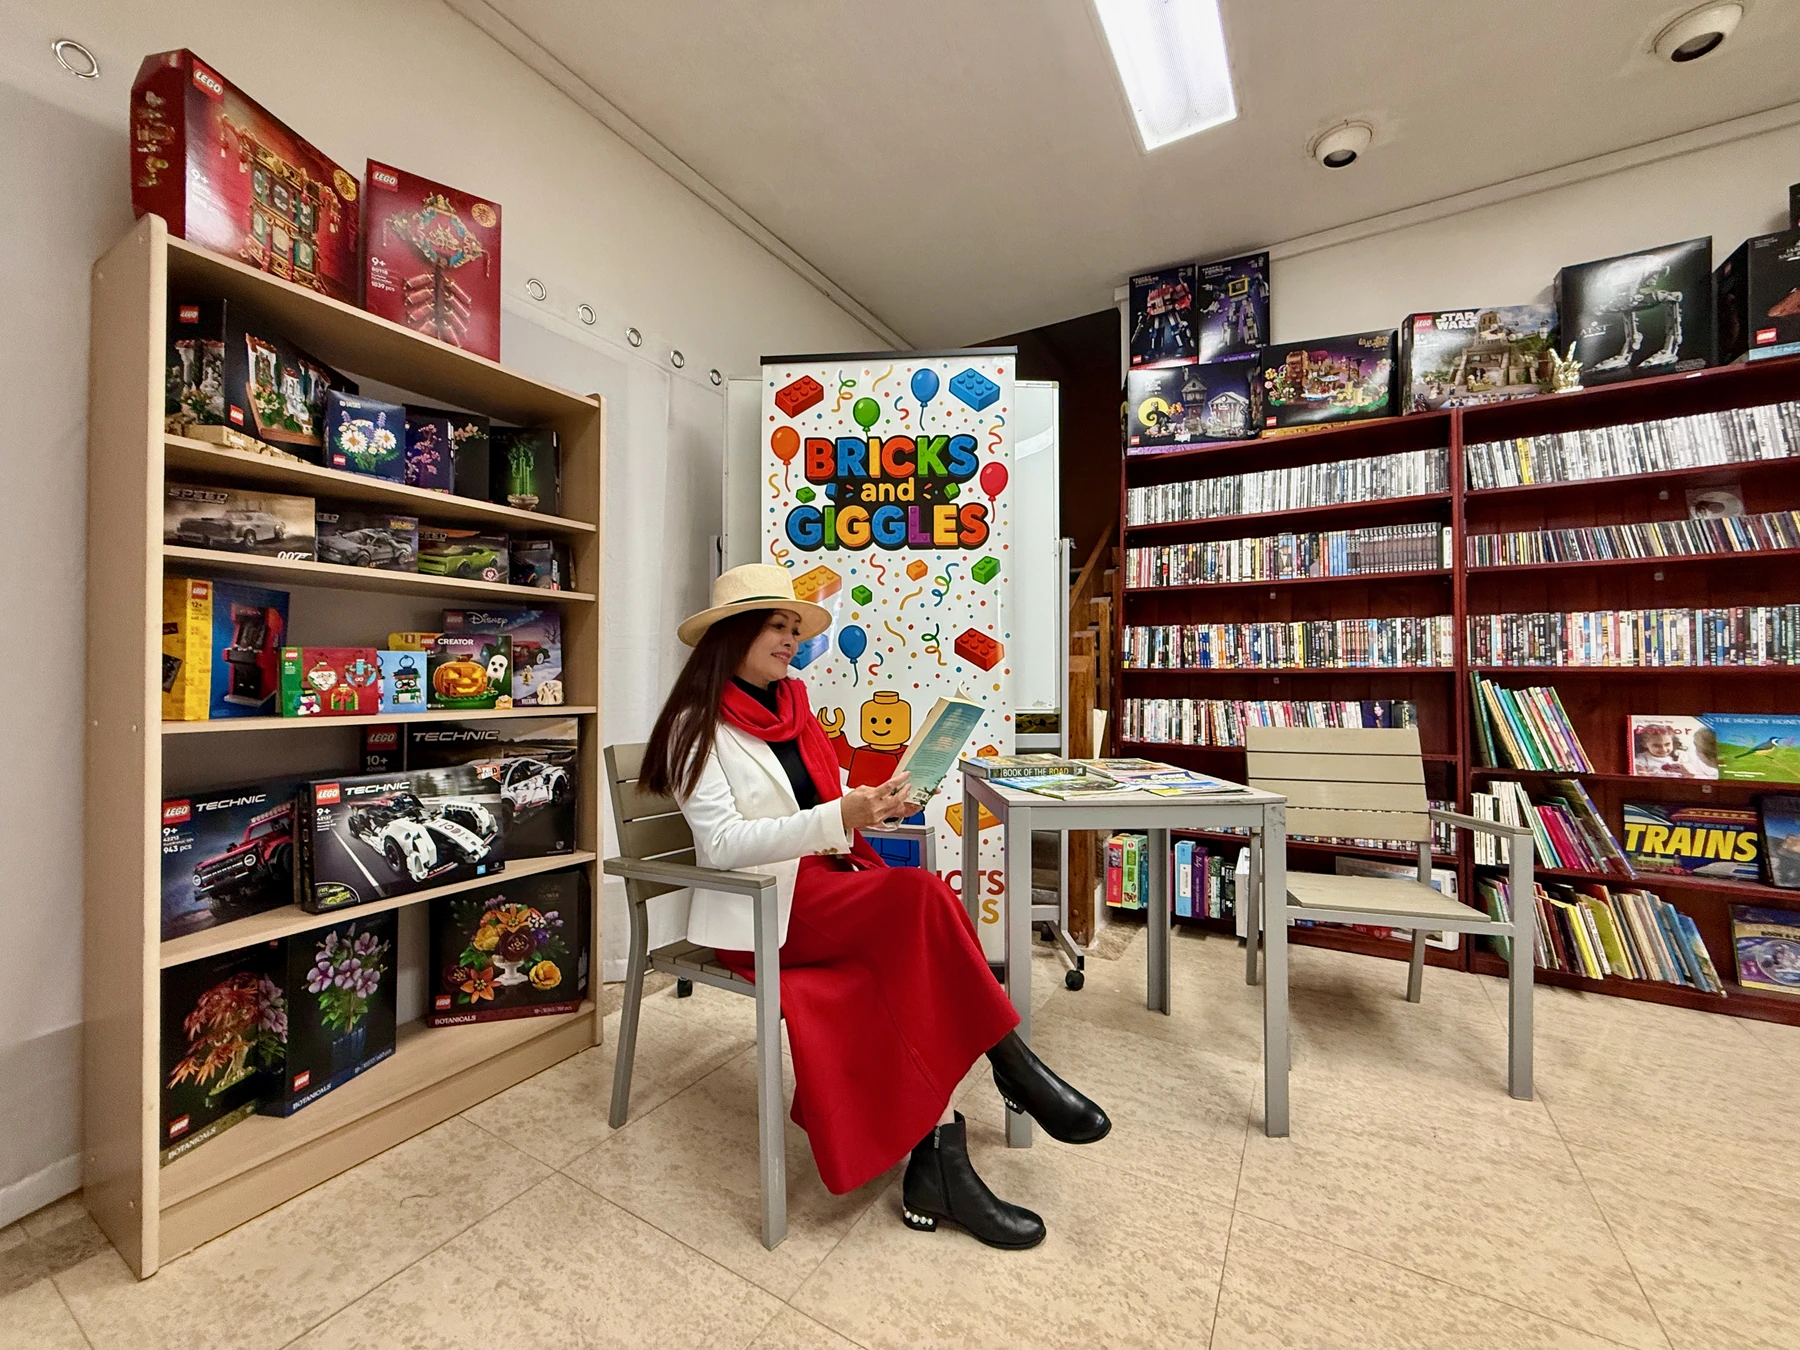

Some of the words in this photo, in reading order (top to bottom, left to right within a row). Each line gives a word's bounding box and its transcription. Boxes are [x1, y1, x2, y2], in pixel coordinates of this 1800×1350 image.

[195, 70, 222, 94] LEGO
[373, 171, 397, 186] LEGO
[371, 256, 386, 266] 9+
[180, 309, 198, 319] LEGO
[1441, 311, 1477, 322] STAR
[1436, 319, 1477, 330] WARS
[804, 434, 979, 482] BRICKS
[168, 488, 229, 502] SPEED
[860, 476, 915, 502] and
[786, 502, 990, 550] GIGGLES
[447, 616, 463, 625] LEGO
[466, 611, 508, 627] Disney
[421, 637, 435, 646] LEGO
[437, 638, 474, 647] CREATOR
[369, 731, 397, 743] LEGO
[412, 730, 500, 742] TECHNIC
[366, 755, 388, 766] 10+
[1003, 768, 1022, 777] BOOK
[1023, 768, 1033, 776] OF
[1034, 767, 1047, 775] THE
[1048, 766, 1069, 775] ROAD
[317, 788, 339, 799] LEGO
[345, 781, 410, 795] TECHNIC
[164, 805, 190, 818] LEGO
[195, 793, 267, 812] TECHNIC
[316, 807, 331, 816] 9+
[163, 827, 178, 836] 9+
[163, 845, 178, 854] 943
[180, 844, 192, 852] pcs
[1624, 823, 1757, 862] TRAINS
[436, 998, 450, 1006] LEGO
[434, 1015, 477, 1025] BOTANICALS
[292, 1083, 332, 1110] BOTANICALS
[168, 1126, 217, 1160] BOTANICALS
